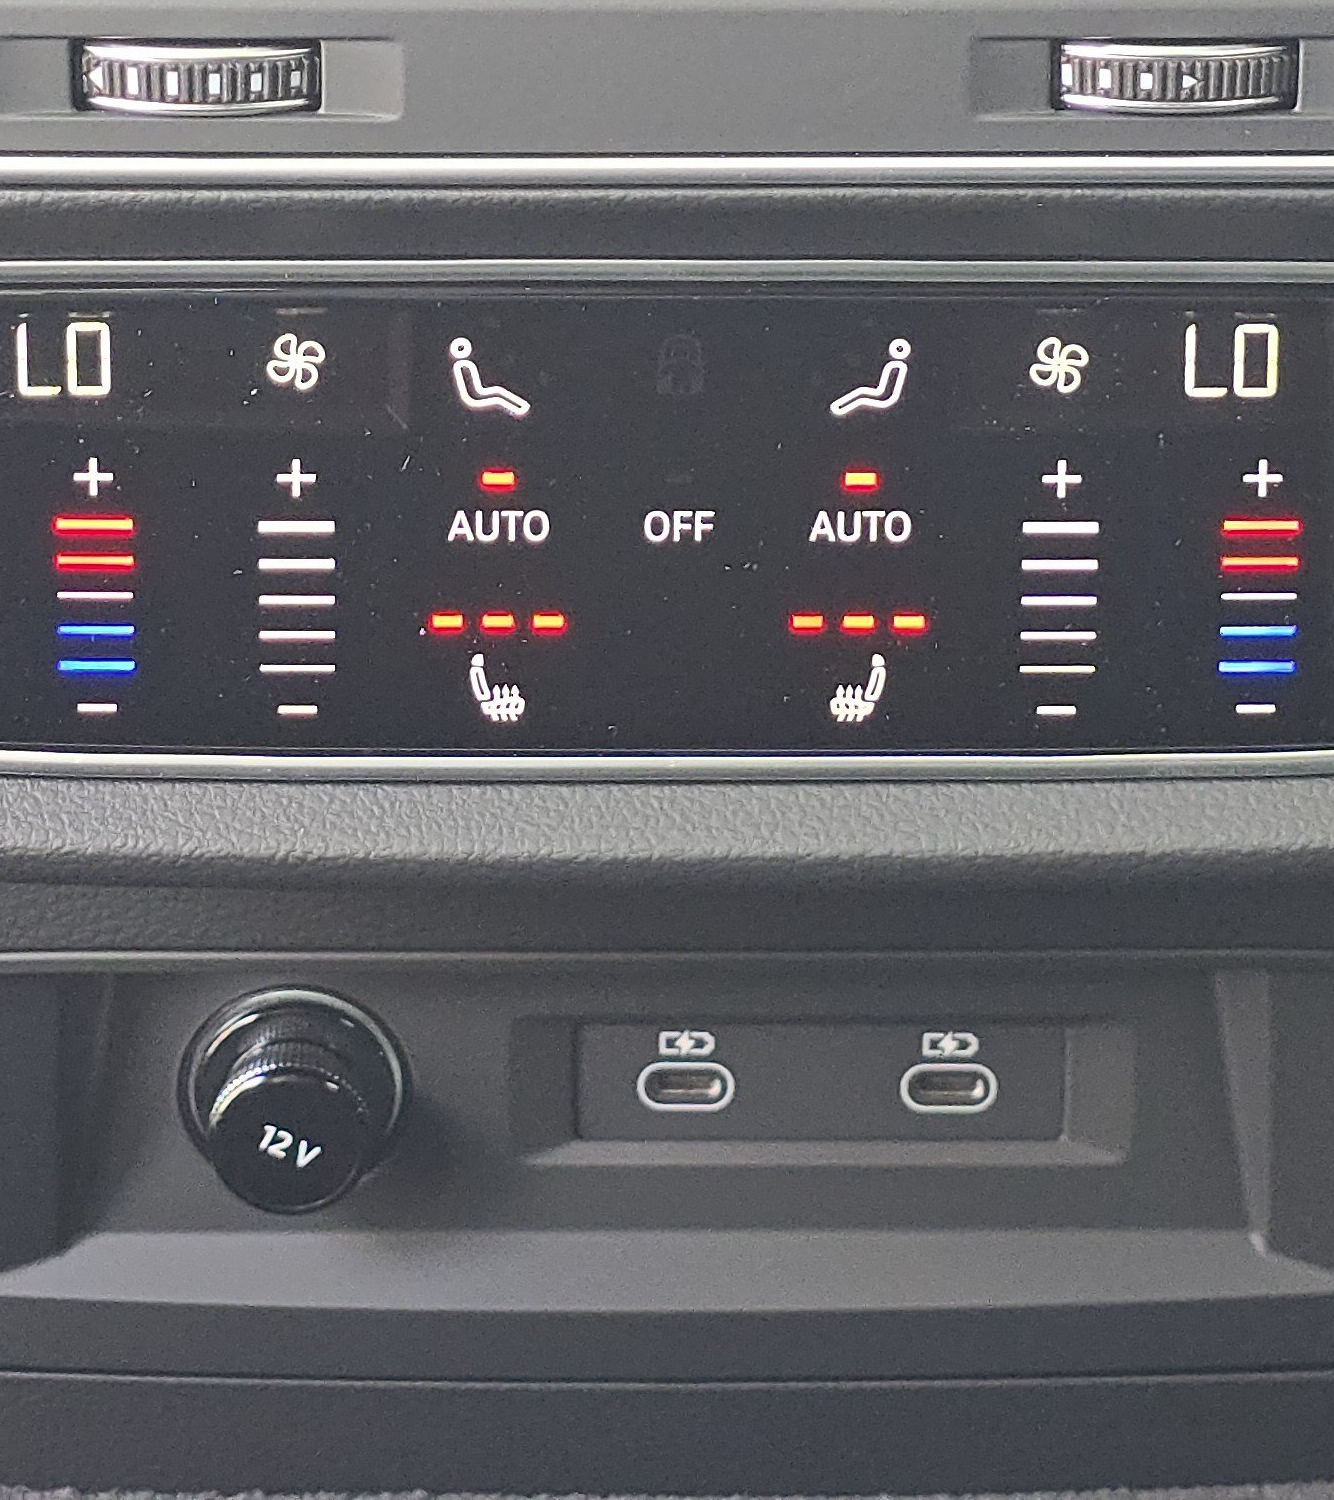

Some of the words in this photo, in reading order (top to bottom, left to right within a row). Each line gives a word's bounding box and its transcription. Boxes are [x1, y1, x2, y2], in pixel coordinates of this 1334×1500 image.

[15, 321, 112, 398] LO
[1183, 322, 1279, 399] LO
[447, 509, 550, 544] AUTO
[643, 510, 716, 544] OFF
[808, 510, 912, 544] AUTO
